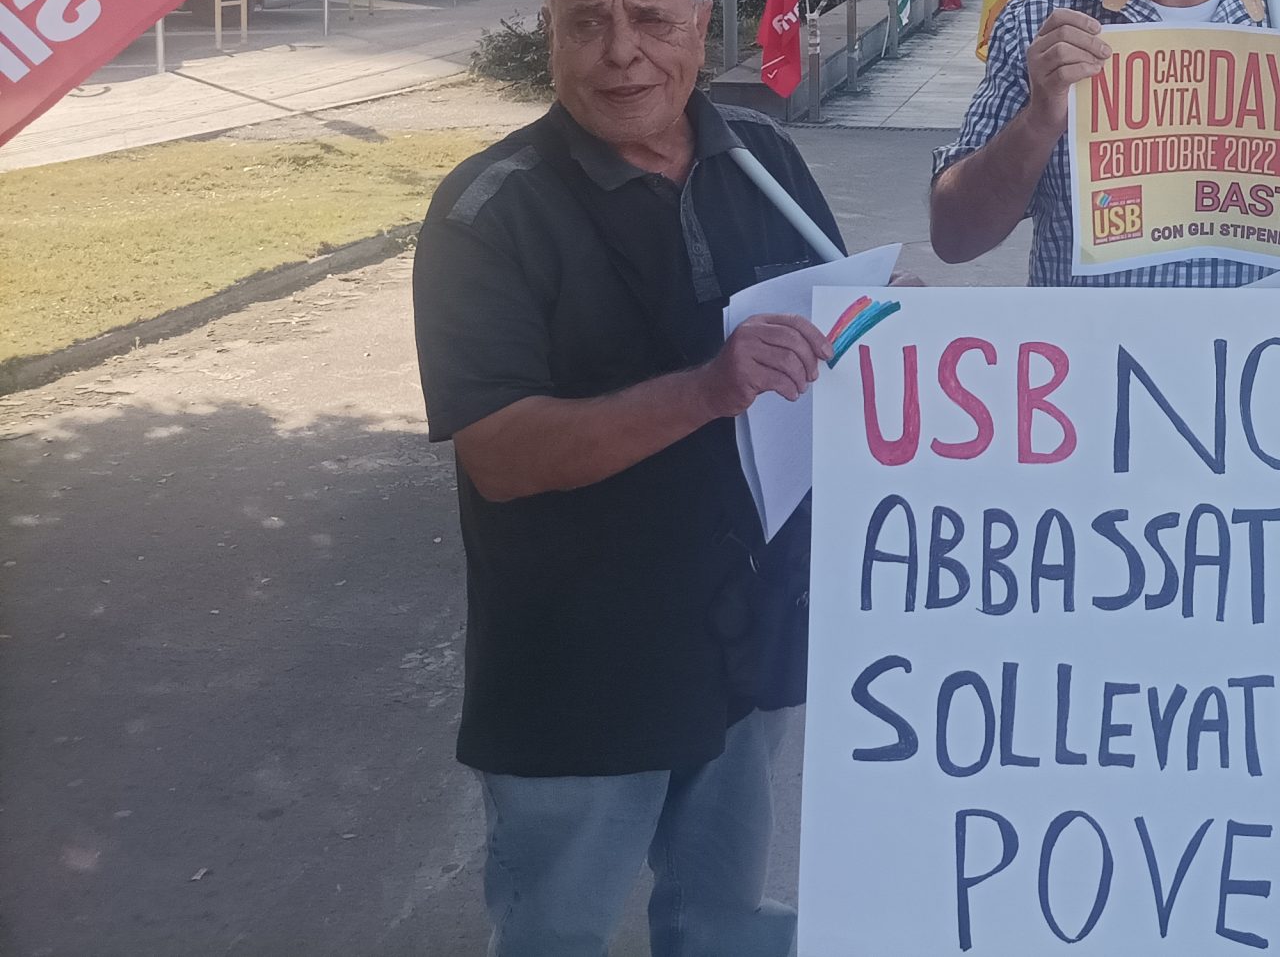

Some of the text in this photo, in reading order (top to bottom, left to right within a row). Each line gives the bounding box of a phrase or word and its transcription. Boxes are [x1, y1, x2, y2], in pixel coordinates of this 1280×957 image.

[1154, 49, 1205, 84] CARO
[1091, 50, 1150, 133] NO
[1153, 88, 1202, 127] VITA
[1099, 137, 1278, 179] 26 OTTOBRE 2022
[1094, 204, 1142, 238] USB
[1151, 223, 1184, 242] CON
[1188, 222, 1214, 236] GLI
[859, 337, 1078, 467] USB
